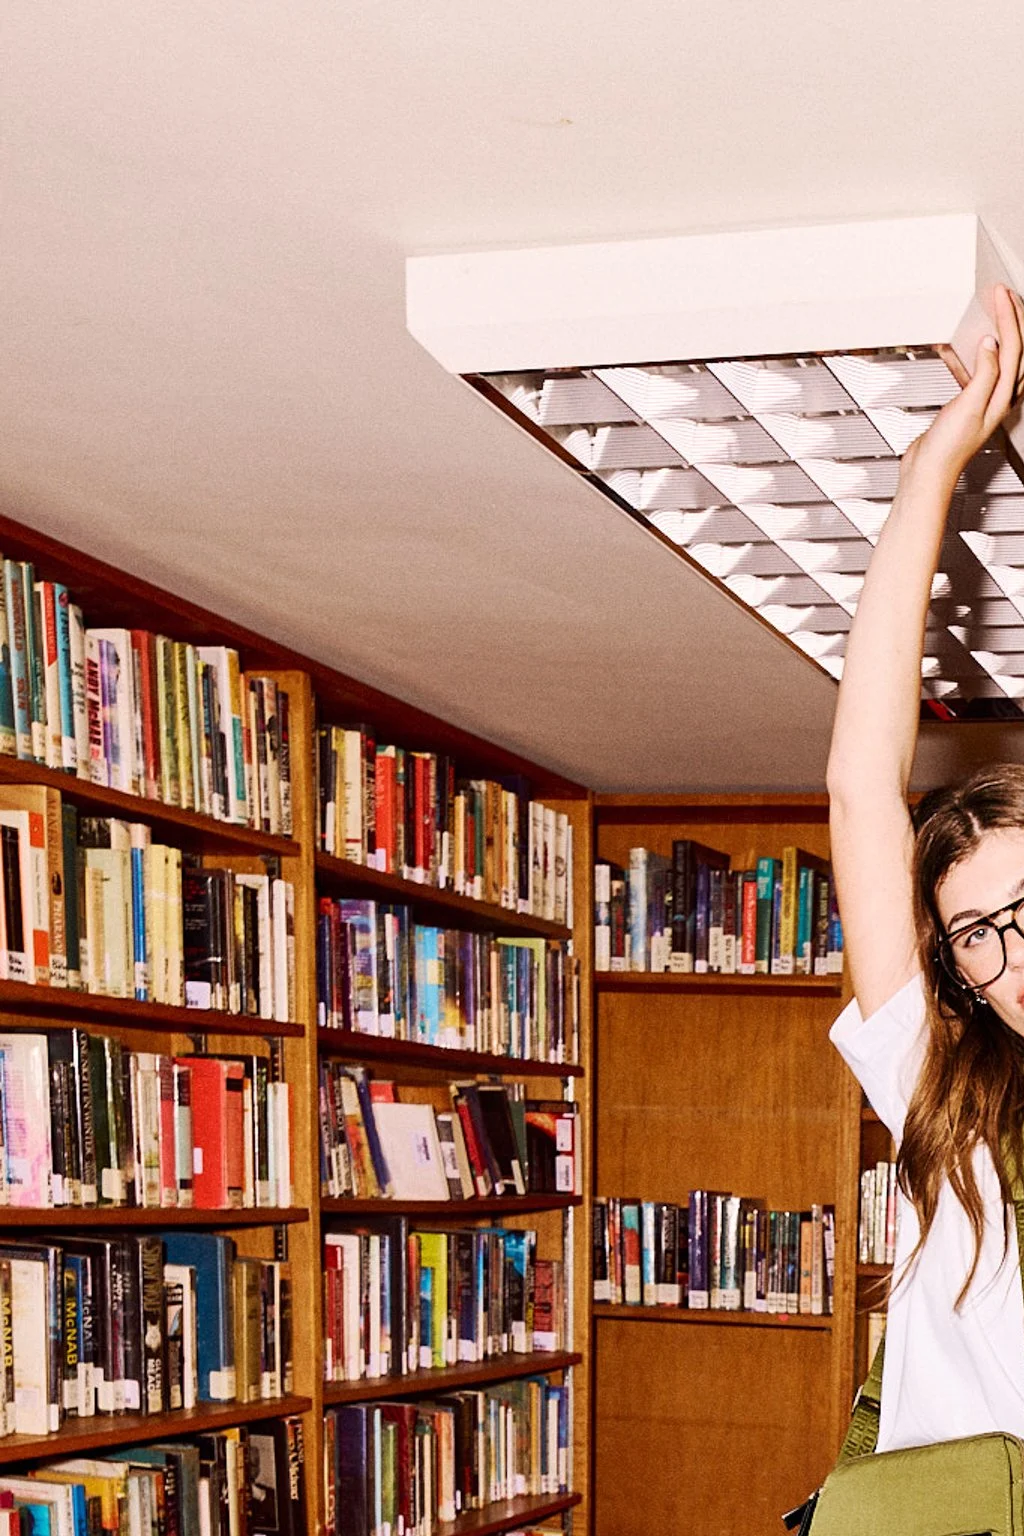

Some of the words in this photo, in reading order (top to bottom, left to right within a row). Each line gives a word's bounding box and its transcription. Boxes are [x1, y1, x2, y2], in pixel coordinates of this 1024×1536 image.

[87, 658, 99, 690] ANDY
[88, 697, 101, 746] McNAB
[2, 1297, 12, 1367] McNAB
[65, 1301, 77, 1365] McNAB
